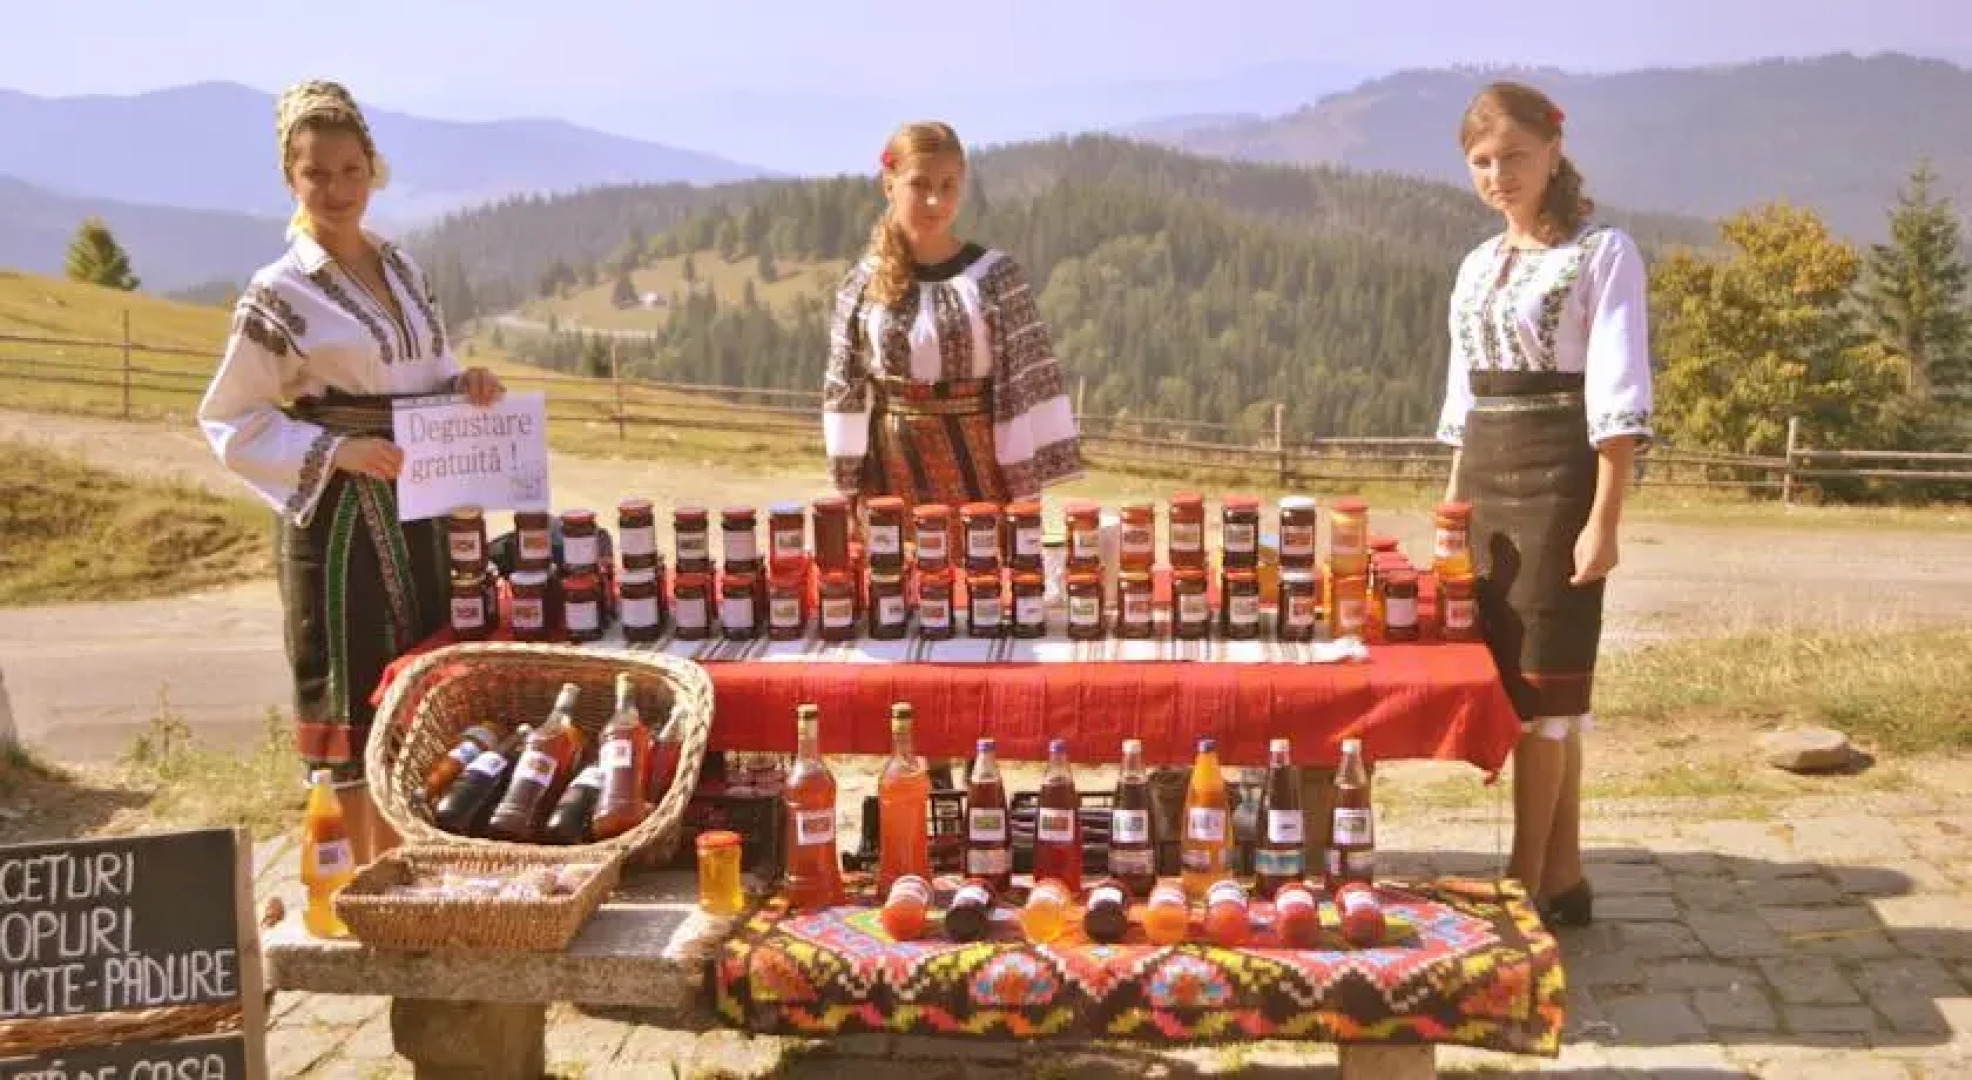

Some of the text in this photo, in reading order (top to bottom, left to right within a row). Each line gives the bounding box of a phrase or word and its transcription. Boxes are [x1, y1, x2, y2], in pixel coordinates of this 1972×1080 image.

[410, 412, 532, 443] Degustare
[0, 852, 135, 904] CETURI
[1, 907, 134, 963] OPURI
